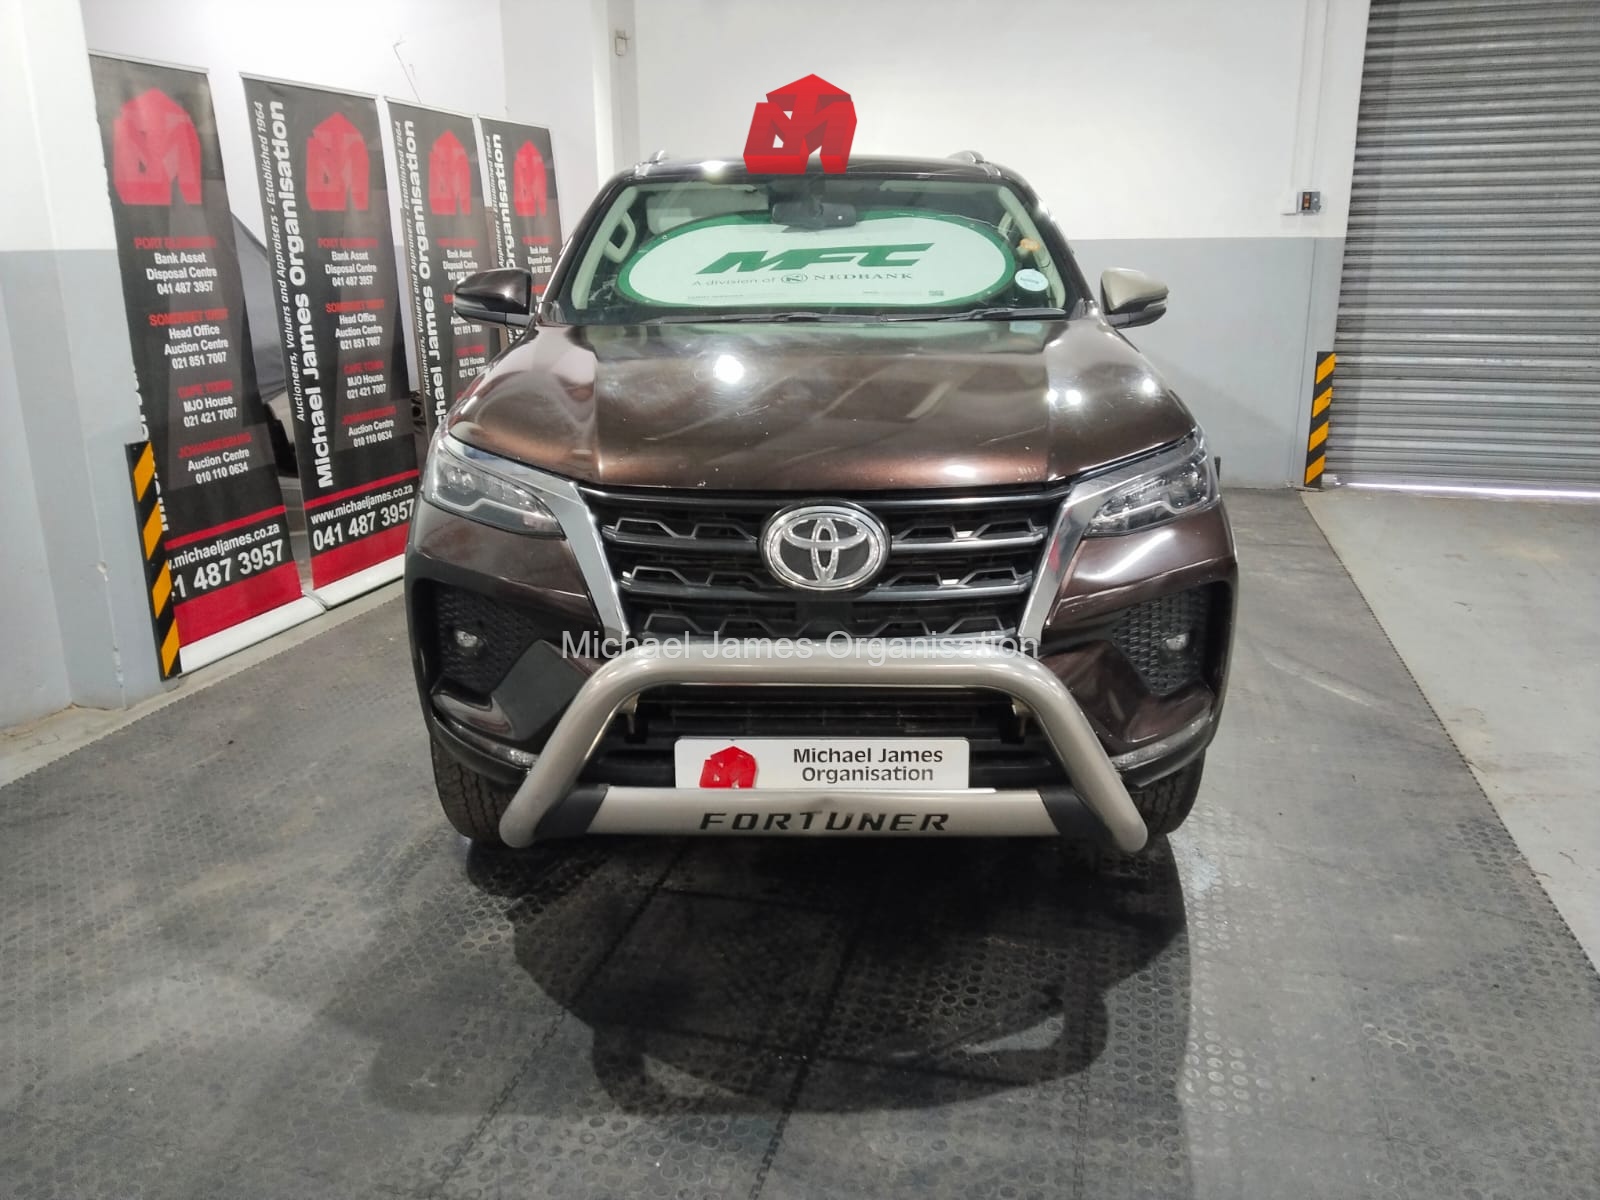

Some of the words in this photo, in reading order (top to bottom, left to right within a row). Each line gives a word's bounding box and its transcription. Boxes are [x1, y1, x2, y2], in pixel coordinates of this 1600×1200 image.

[254, 101, 267, 134] 1964
[259, 135, 276, 206] Established
[270, 214, 287, 280] Appraisers
[331, 251, 350, 261] Bank
[154, 252, 179, 265] Bank
[180, 252, 206, 264] Asset
[695, 242, 936, 275] MFC
[145, 267, 188, 281] Disposal
[188, 266, 218, 278] Centre
[324, 263, 356, 276] Disposal
[356, 263, 377, 273] Centre
[814, 271, 913, 281] NEDBANK
[156, 283, 174, 295] 041
[175, 281, 191, 294] 487
[194, 280, 214, 293] 3957
[277, 280, 289, 303] and
[282, 305, 295, 349] Valuers
[339, 314, 357, 325] Head
[357, 312, 377, 323] Office
[422, 285, 440, 361] James
[168, 327, 193, 340] Head
[193, 324, 220, 337] Office
[295, 293, 319, 380] James
[335, 327, 362, 338] Auction
[361, 325, 383, 335] Centre
[164, 342, 199, 355] Auction
[200, 339, 229, 351] Centre
[171, 356, 188, 370] 021
[189, 354, 206, 367] 851
[206, 351, 227, 365] 7007
[289, 352, 305, 422] Auctioneers,
[362, 374, 384, 384] House
[183, 400, 204, 413] MJO
[204, 395, 233, 409] House
[346, 389, 359, 400] 021
[183, 415, 199, 428] 021
[200, 411, 217, 424] 421
[217, 407, 237, 421] 7007
[305, 386, 334, 489] Michael
[348, 424, 374, 437] Auction
[373, 419, 394, 430] Centre
[188, 455, 222, 472] Auction
[222, 448, 250, 463] Centre
[195, 471, 211, 485] 010
[212, 467, 228, 481] 110
[310, 484, 413, 525] www.michaeljames.co.za
[313, 522, 343, 551] 041
[348, 511, 376, 537] 487
[380, 498, 415, 527] 3957
[193, 557, 232, 591] 487
[239, 539, 284, 577] 3957
[793, 747, 872, 764] Michael
[877, 747, 944, 764] James
[802, 765, 934, 784] Organisation
[699, 812, 950, 832] FORTUNER
